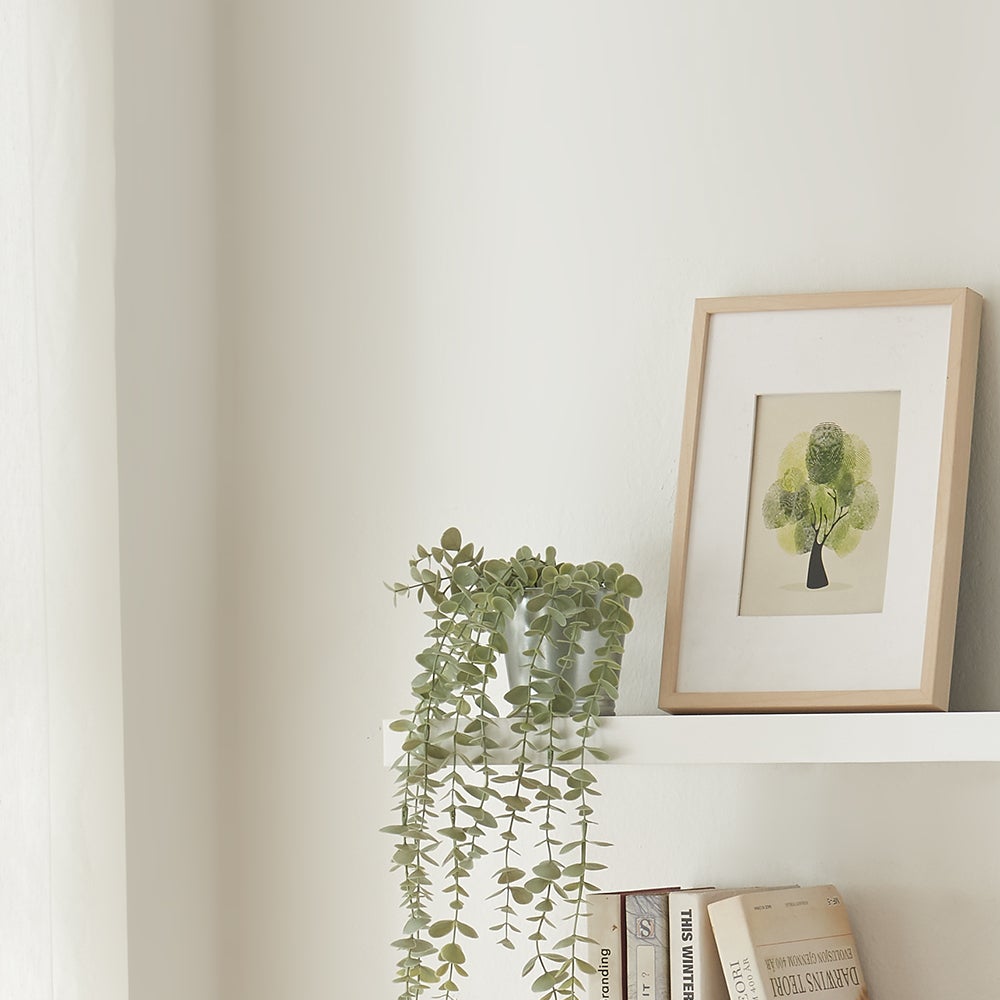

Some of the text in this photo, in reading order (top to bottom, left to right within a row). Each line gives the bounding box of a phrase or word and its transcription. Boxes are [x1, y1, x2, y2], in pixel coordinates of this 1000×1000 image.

[681, 909, 693, 942] THIS
[743, 958, 752, 971] ÅR
[642, 984, 650, 997] IT
[747, 974, 756, 992] 400
[770, 966, 860, 997] DARWINS TEORI
